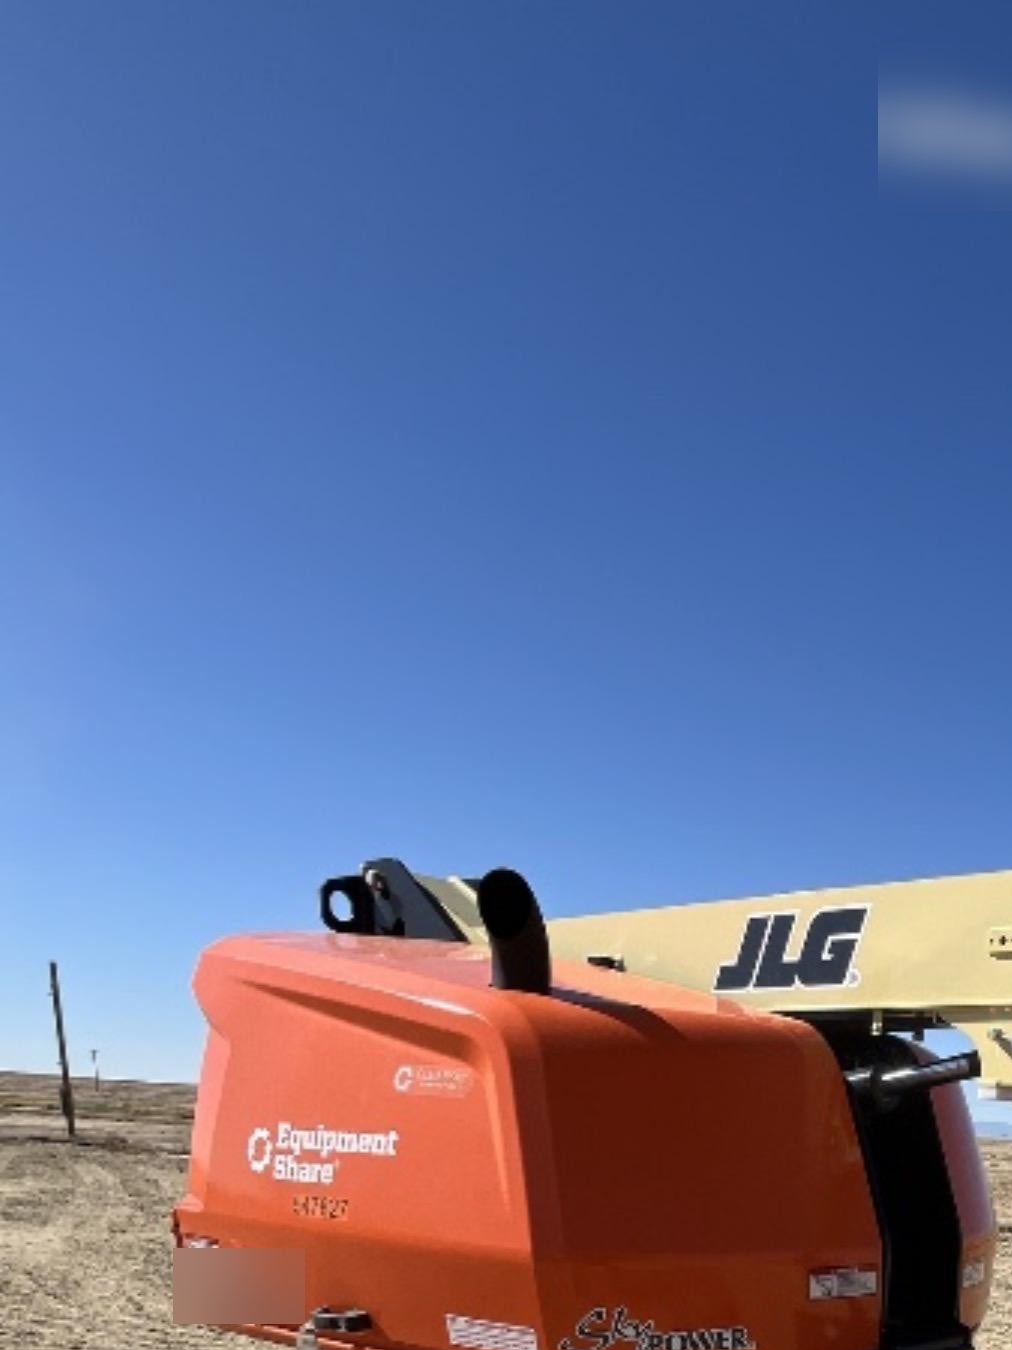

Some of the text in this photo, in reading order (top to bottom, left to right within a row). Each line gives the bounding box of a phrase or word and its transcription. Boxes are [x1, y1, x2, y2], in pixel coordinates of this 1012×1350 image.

[714, 904, 872, 992] JLG
[276, 1122, 399, 1157] Equipment
[274, 1154, 335, 1185] Share
